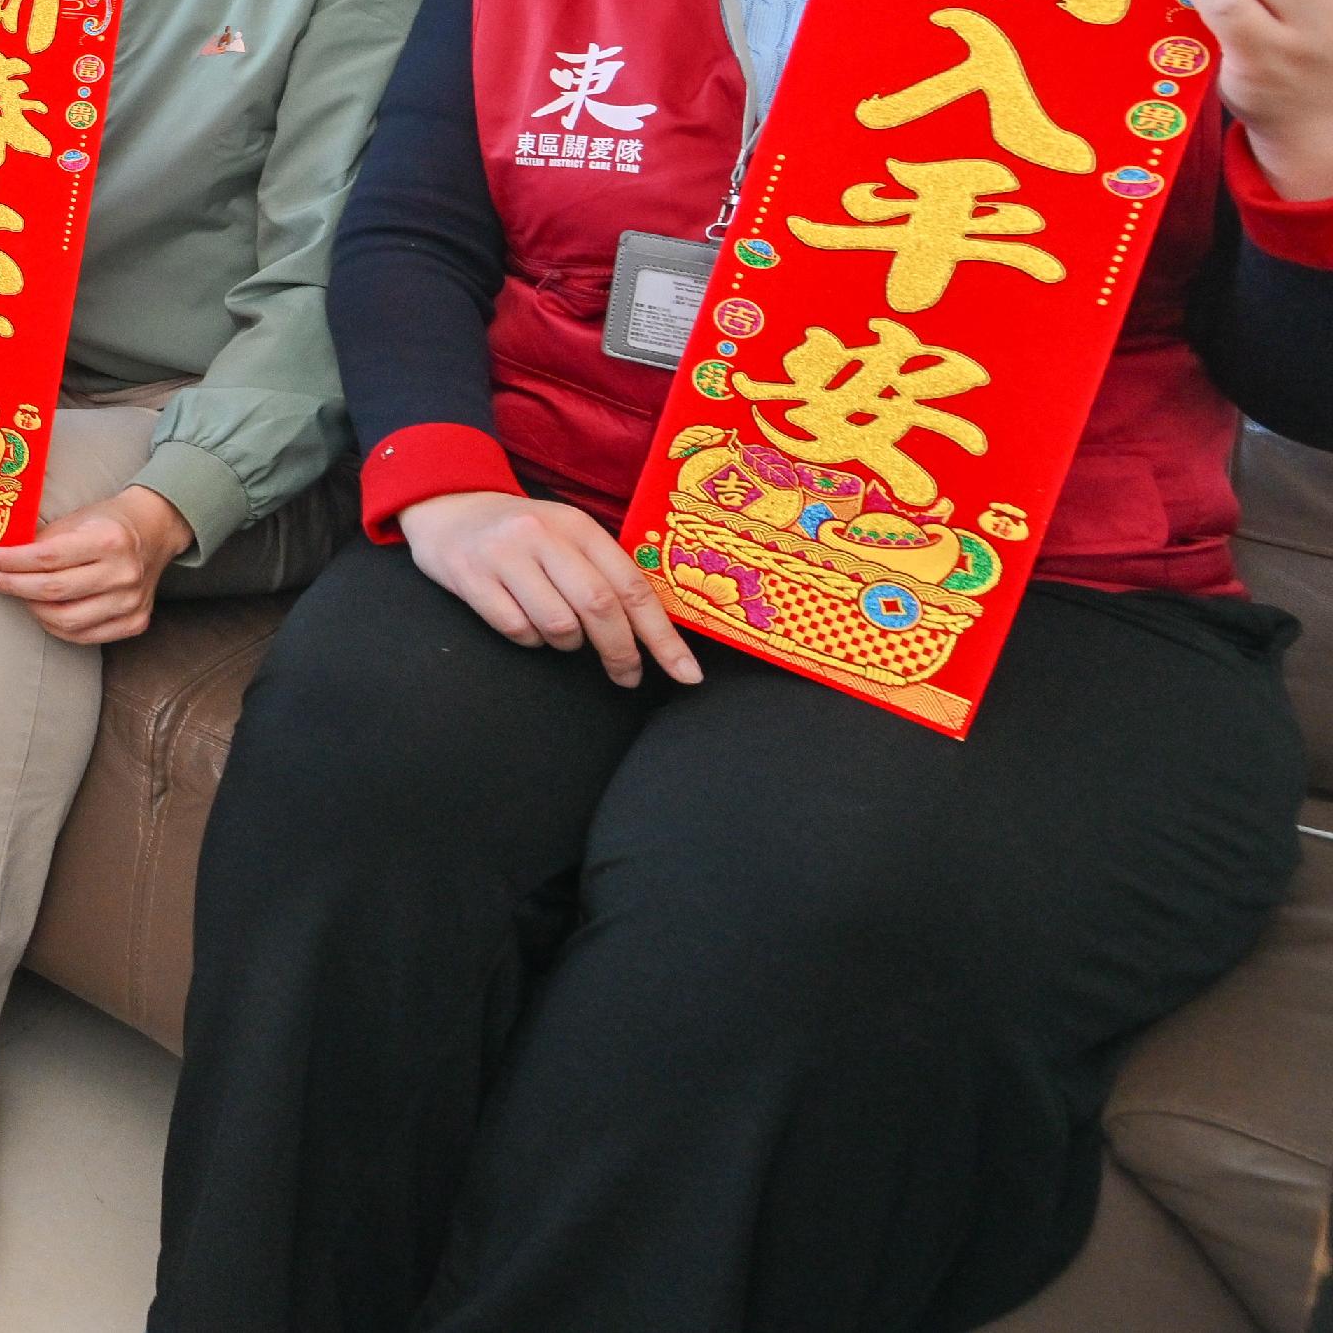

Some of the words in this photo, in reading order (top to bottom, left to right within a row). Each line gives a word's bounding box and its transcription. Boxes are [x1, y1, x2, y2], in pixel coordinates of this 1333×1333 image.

[515, 132, 645, 164] 東區關愛隊
[616, 163, 641, 174] TEAM
[712, 472, 751, 508] 吉
